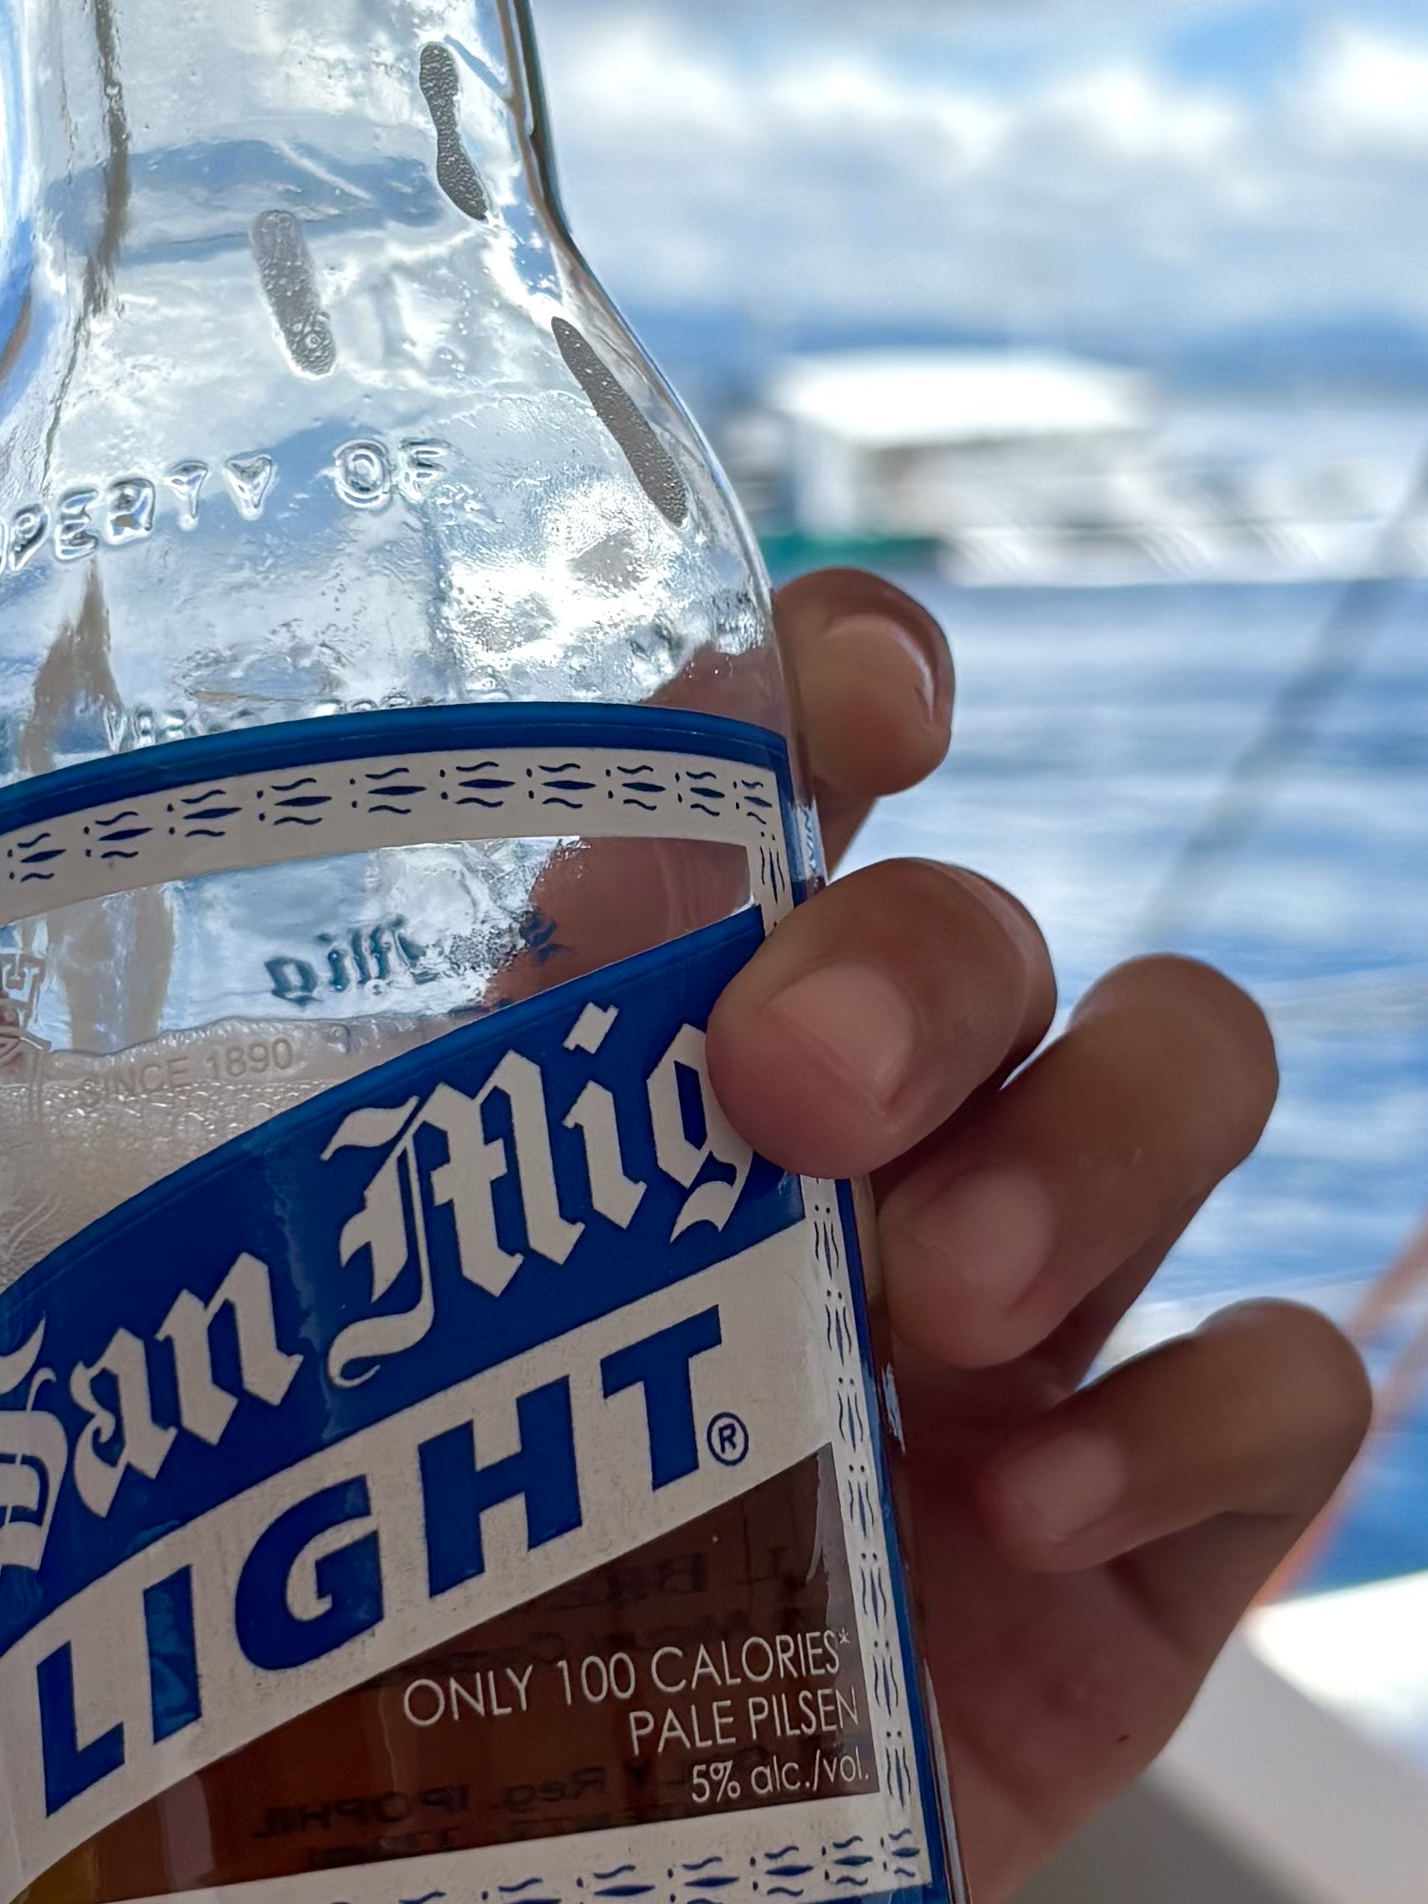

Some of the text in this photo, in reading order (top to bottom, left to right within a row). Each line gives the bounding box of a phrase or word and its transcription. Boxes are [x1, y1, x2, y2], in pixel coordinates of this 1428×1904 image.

[333, 437, 452, 513] OF
[206, 1037, 294, 1080] 1890
[320, 1003, 754, 1389] Mig
[403, 1664, 534, 1728] ONLY
[557, 1651, 637, 1706] 100
[629, 1686, 859, 1757] PALE PILSEN
[690, 1759, 741, 1804] 5%
[751, 1745, 870, 1794] alc./vol.
